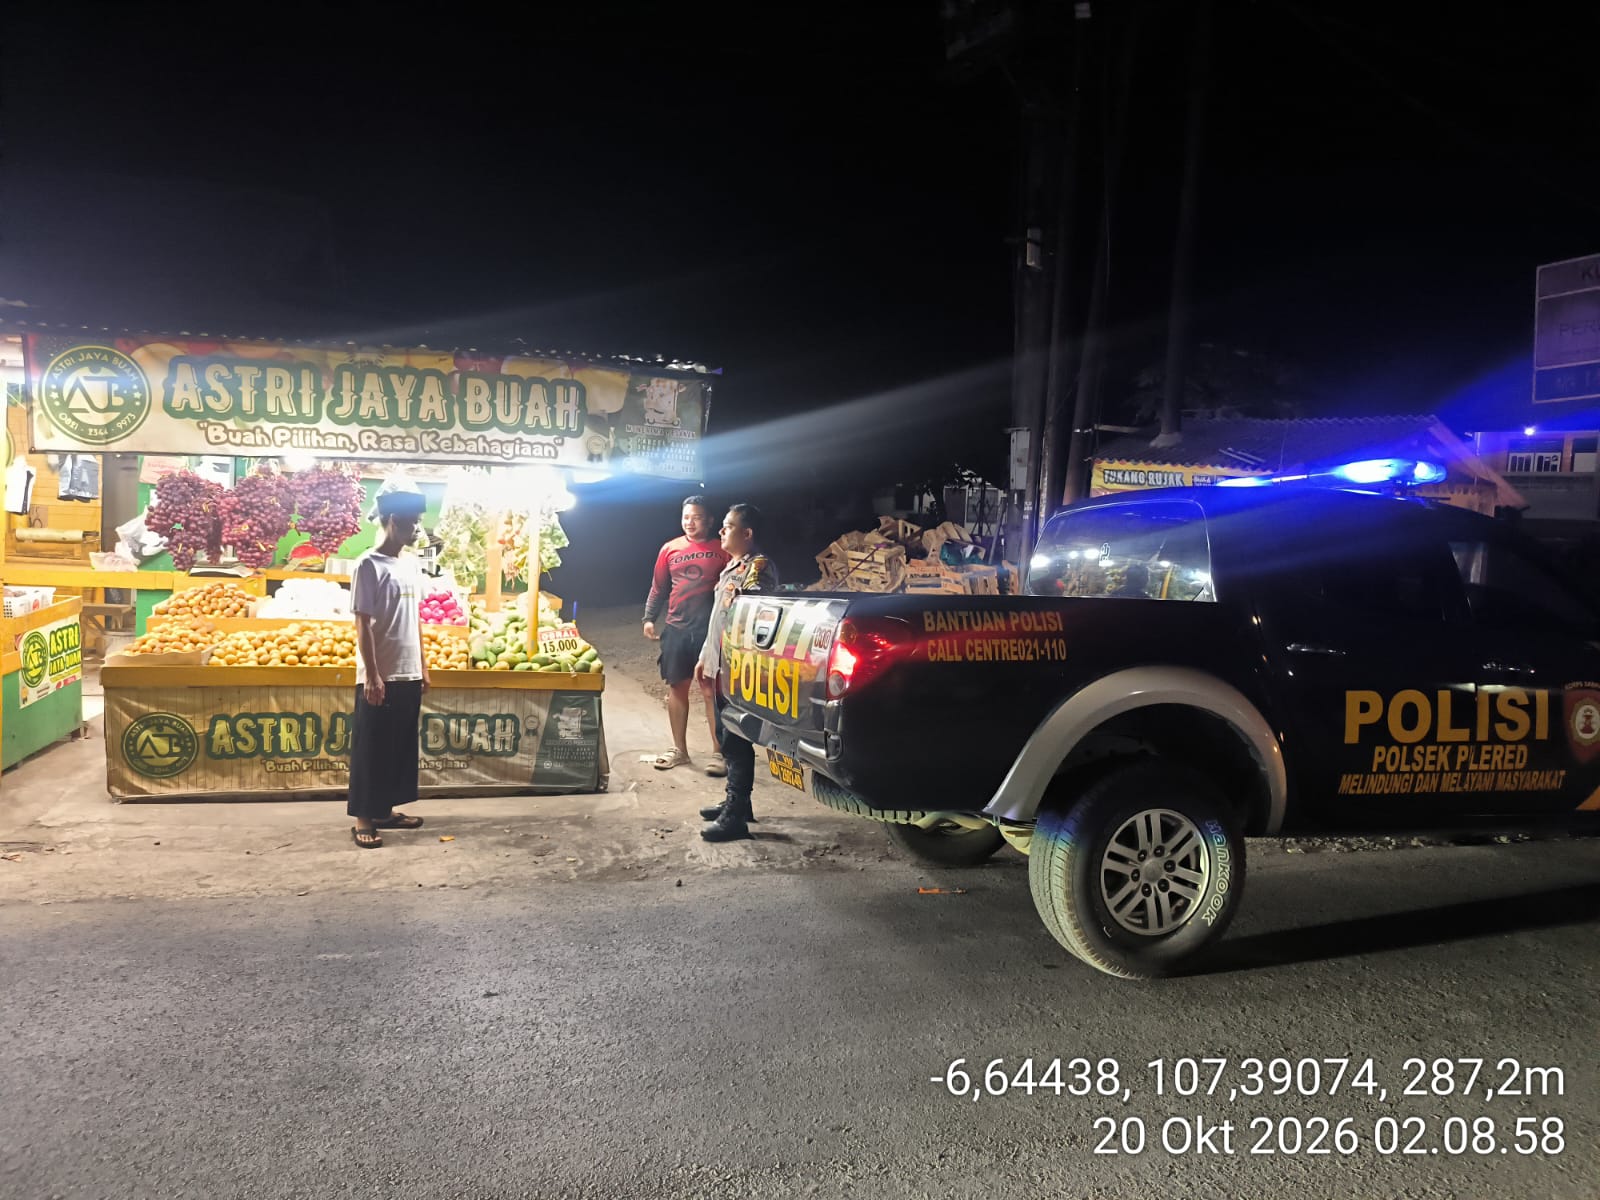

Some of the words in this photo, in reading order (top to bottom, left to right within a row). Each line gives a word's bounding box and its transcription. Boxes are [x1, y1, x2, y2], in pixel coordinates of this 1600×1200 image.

[52, 357, 76, 380] ASTRI
[78, 352, 109, 363] JAYA
[112, 357, 139, 382] BUAH
[169, 363, 317, 419] ASTRI
[334, 370, 448, 424] JAYA
[464, 376, 582, 432] BUAH
[273, 428, 358, 451] Pilihan,
[359, 430, 418, 453] Rasa
[1103, 469, 1146, 485] TUKANG
[1147, 471, 1185, 487] RUJAK
[923, 610, 1006, 633] BANTUAN
[1009, 610, 1064, 632] POLISI
[50, 624, 80, 656] ASTRI
[542, 638, 578, 654] 15.000
[927, 639, 963, 662] CALL
[729, 650, 800, 719] POLISI
[1344, 689, 1549, 744] POLISI
[211, 716, 316, 754] ASTRI
[425, 717, 517, 753] BUAH
[1372, 745, 1451, 773] POLSEK
[1455, 744, 1529, 771] PLERED
[1338, 773, 1414, 795] MELINDUNGI
[1414, 773, 1439, 793] DAN
[1439, 772, 1496, 793] MELAYANI
[1497, 770, 1567, 792] MASYARAKAT
